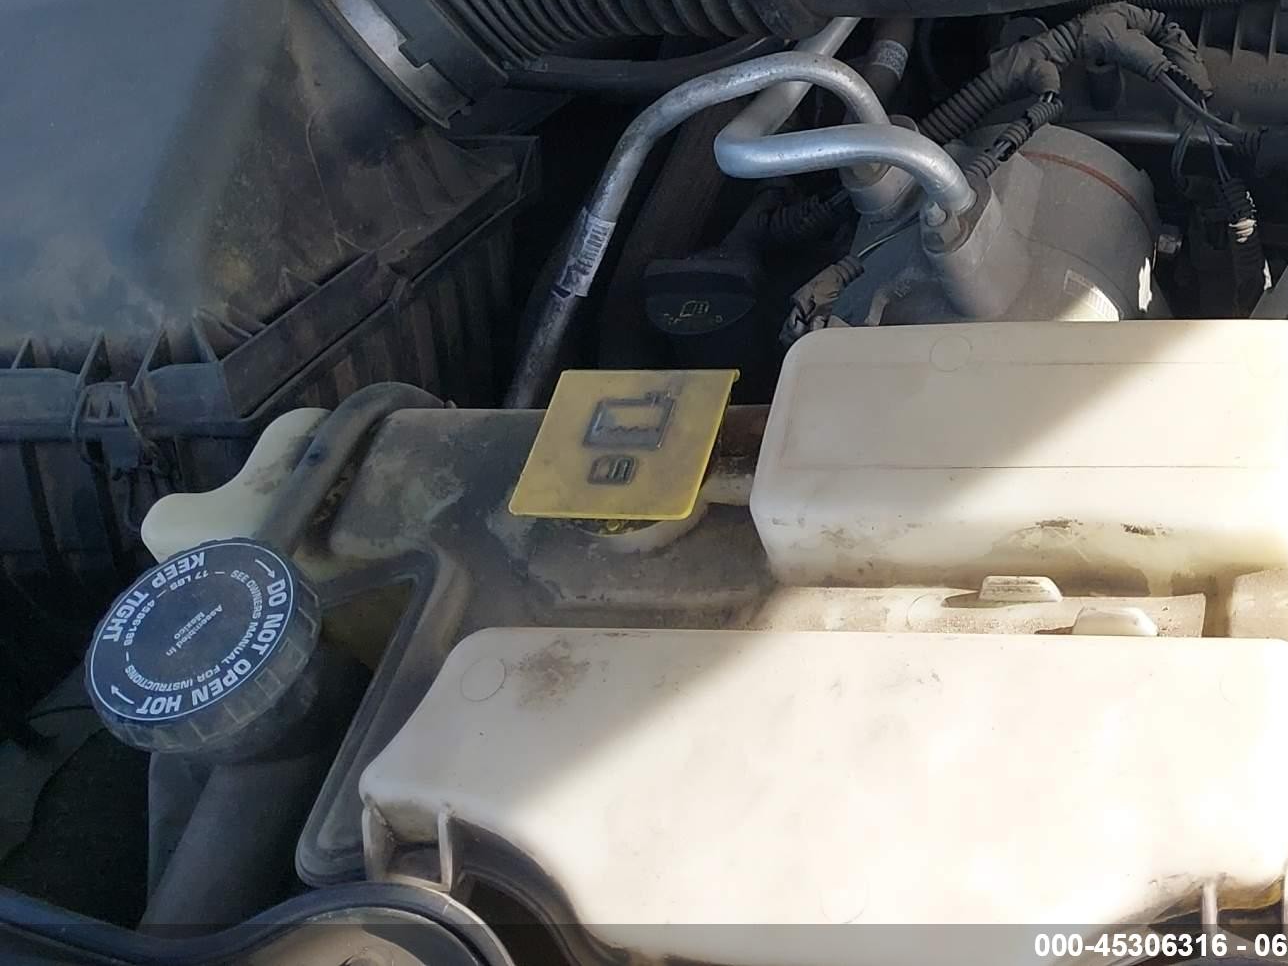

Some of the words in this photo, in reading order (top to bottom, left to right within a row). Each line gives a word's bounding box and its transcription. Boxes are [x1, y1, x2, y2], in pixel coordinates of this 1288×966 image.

[152, 552, 205, 589] KEEP
[231, 569, 247, 582] SEE
[245, 579, 262, 620] OWNERS
[266, 578, 288, 607] DO
[103, 590, 150, 642] TIGHT
[174, 612, 205, 639] Mexico
[176, 604, 222, 648] Assembled
[255, 612, 284, 656] NOT
[222, 620, 260, 664] MANUAL
[124, 665, 194, 692] INSTRUCTIONS
[191, 658, 251, 706] OPEN
[196, 664, 221, 683] FOR
[136, 694, 182, 715] HOT
